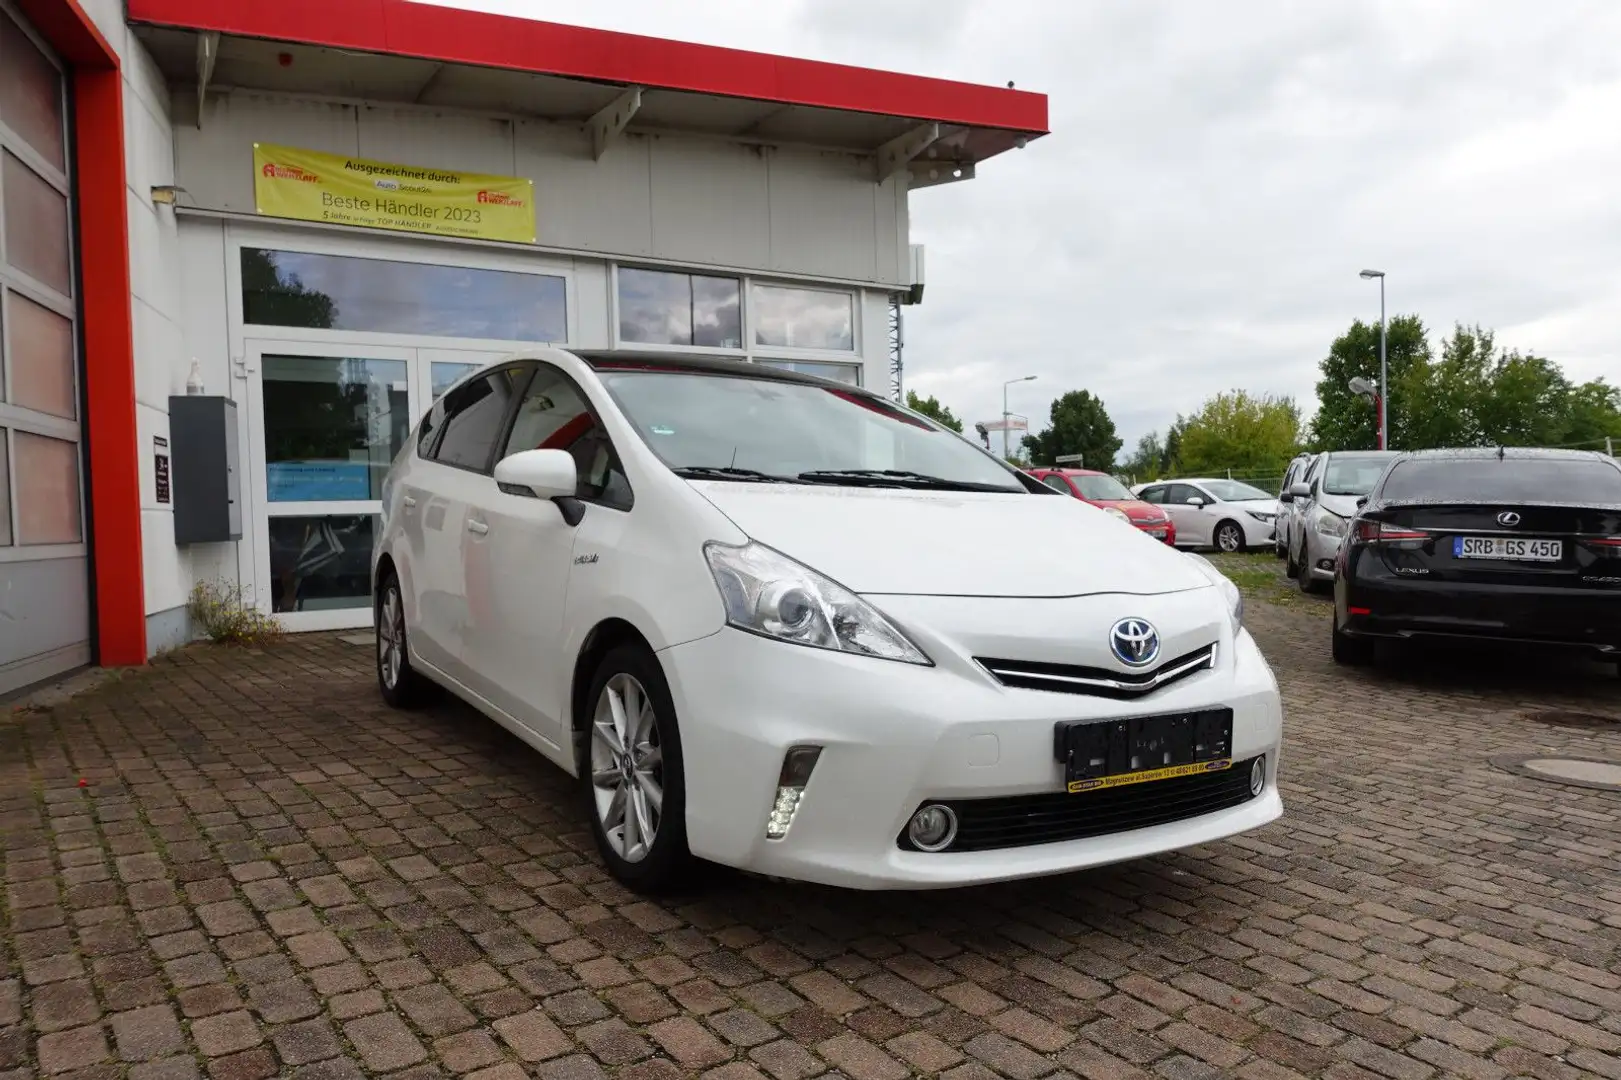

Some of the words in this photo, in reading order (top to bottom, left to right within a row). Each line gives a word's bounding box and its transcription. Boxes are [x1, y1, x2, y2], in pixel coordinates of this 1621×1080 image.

[345, 160, 425, 179] Ausgezeichnet
[428, 172, 460, 184] durch:
[322, 191, 370, 211] Beste
[375, 198, 440, 219] Händler
[443, 206, 481, 223] 2023
[323, 210, 329, 219] 5
[331, 212, 351, 221] Jahre
[377, 217, 393, 226] TOP
[1464, 539, 1493, 554] SRB
[1506, 540, 1526, 555] GS
[1530, 541, 1560, 557] 450
